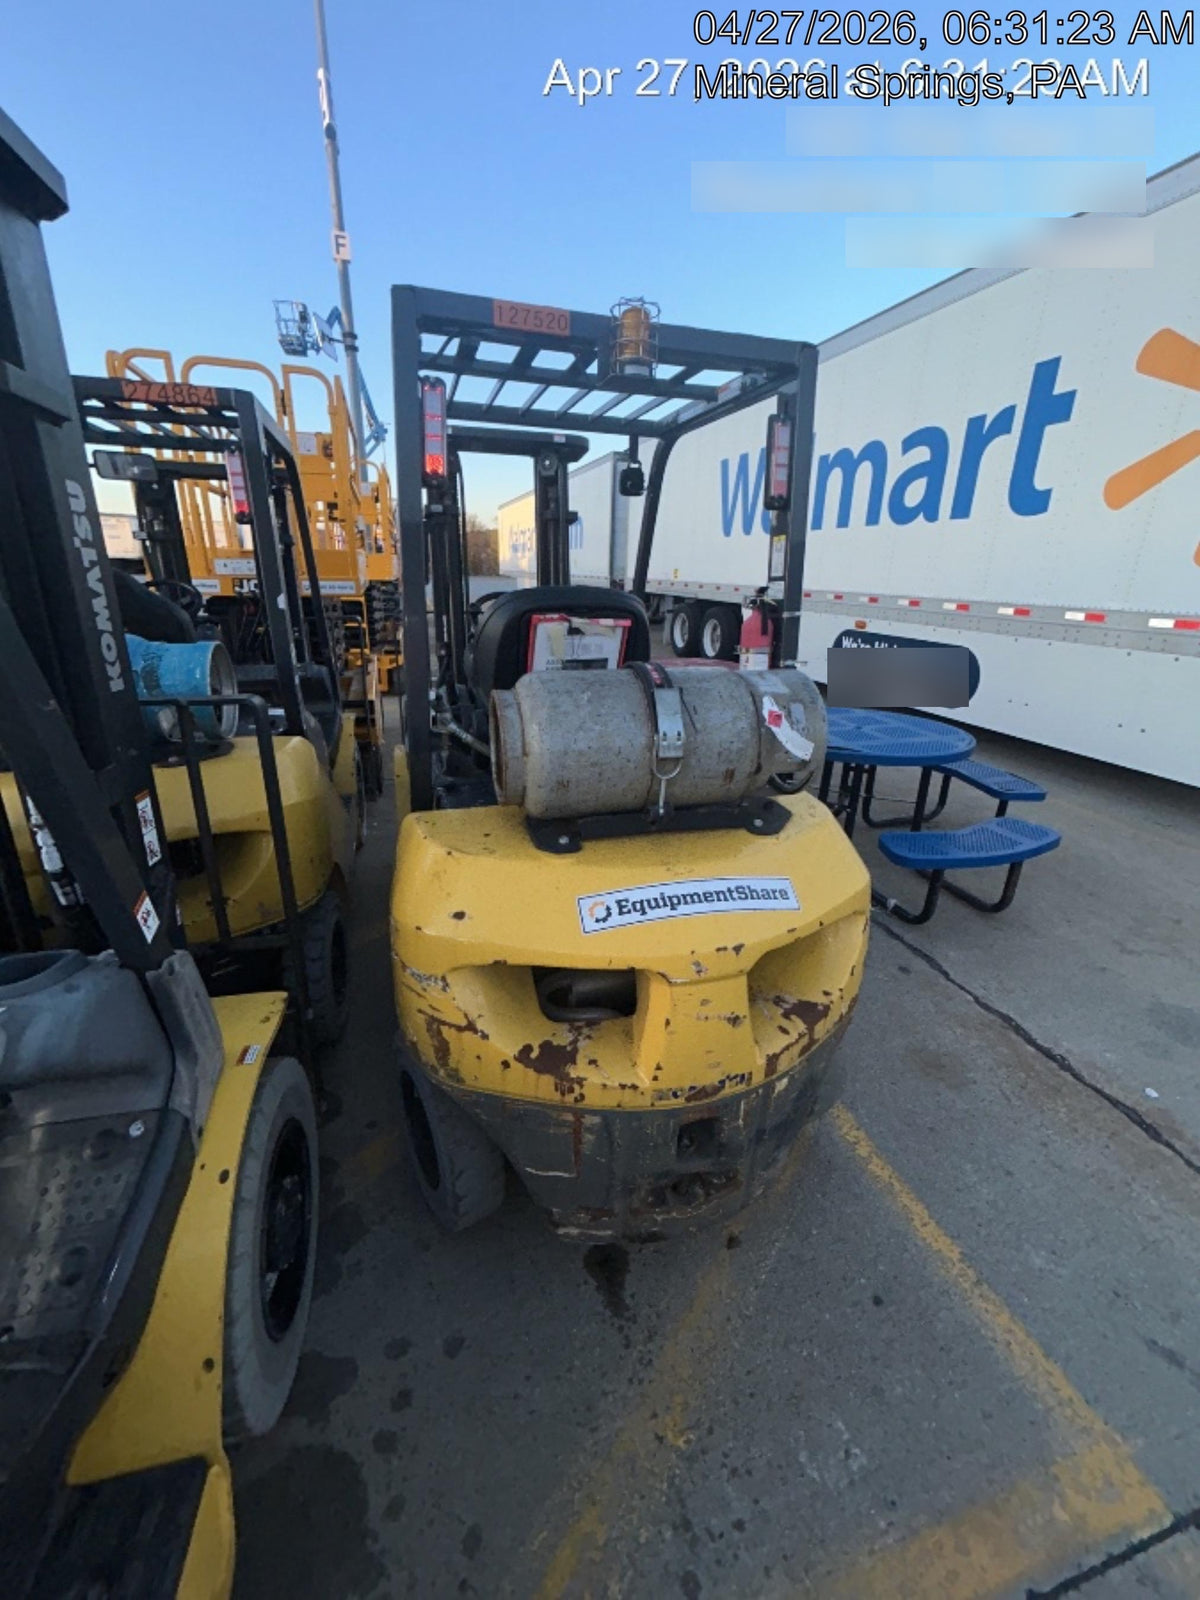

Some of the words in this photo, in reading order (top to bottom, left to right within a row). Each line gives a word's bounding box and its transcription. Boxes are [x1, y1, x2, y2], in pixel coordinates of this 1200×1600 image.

[496, 304, 568, 332] 127520
[125, 382, 216, 406] 274864
[719, 354, 1077, 538] Wmart
[64, 478, 126, 693] KOMATSU
[614, 885, 790, 917] EquipmentShare
